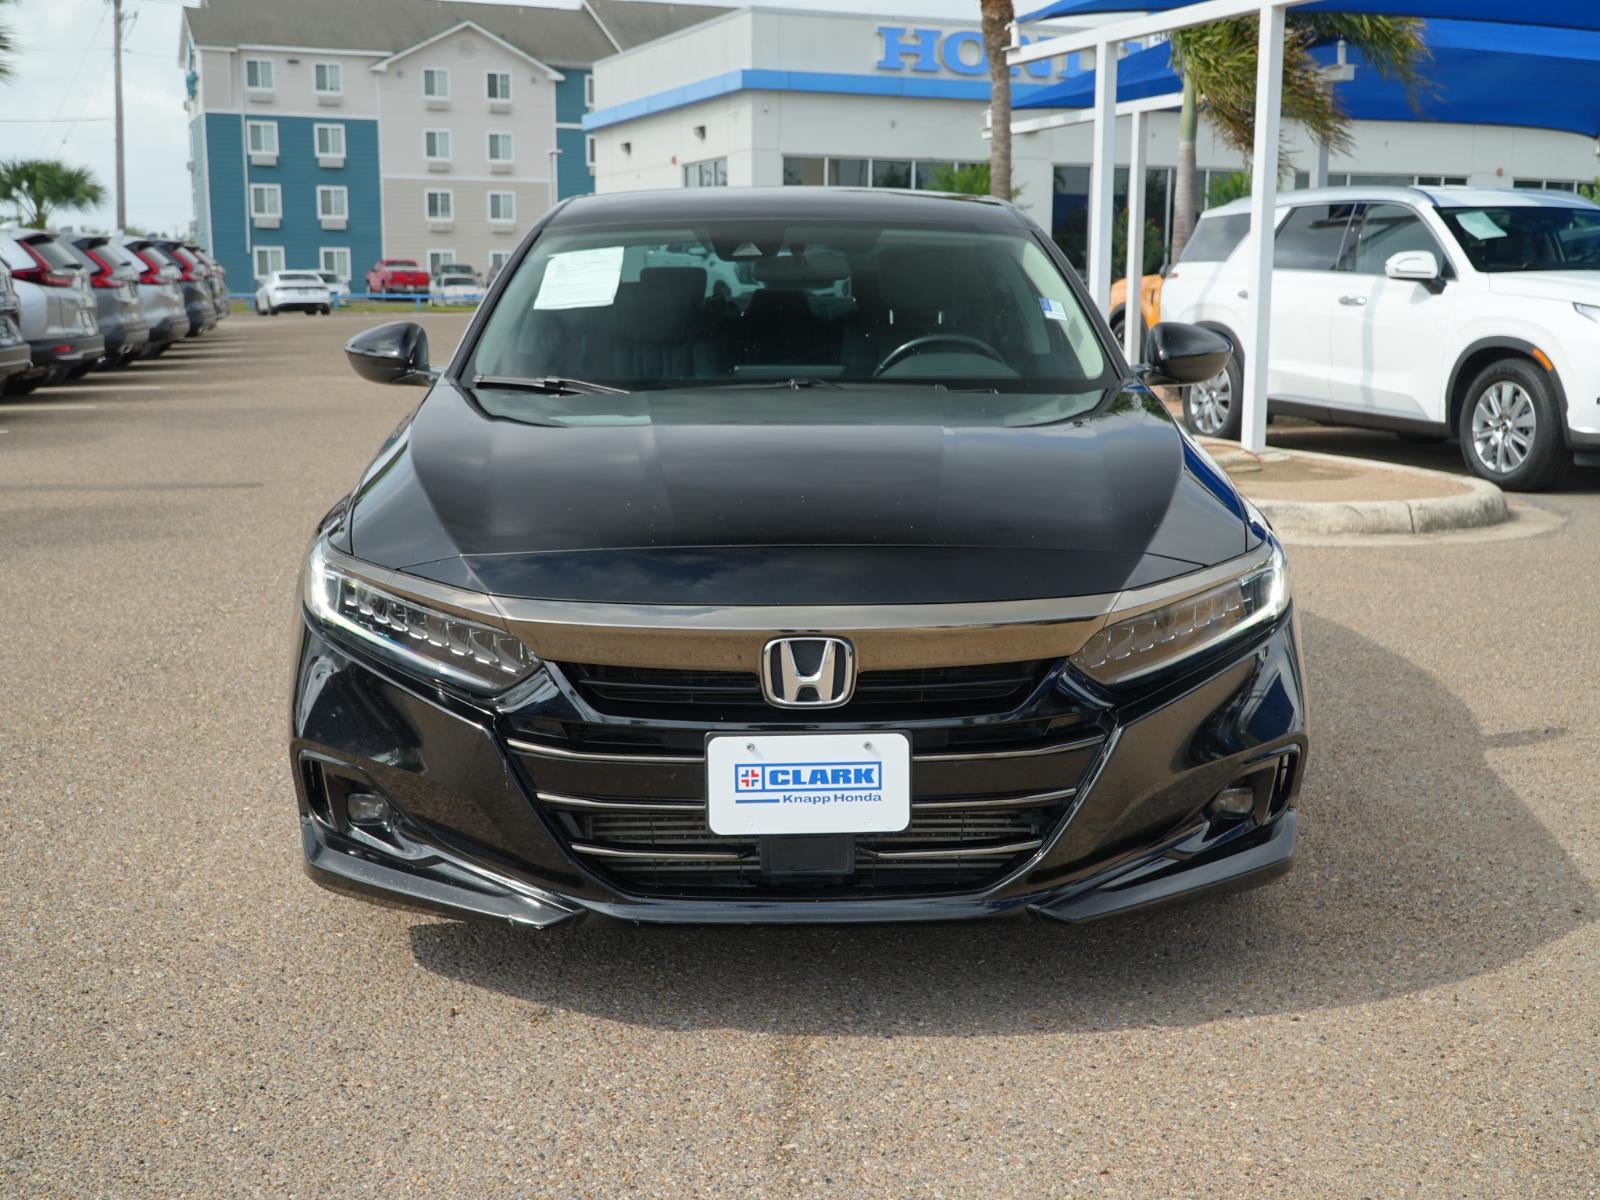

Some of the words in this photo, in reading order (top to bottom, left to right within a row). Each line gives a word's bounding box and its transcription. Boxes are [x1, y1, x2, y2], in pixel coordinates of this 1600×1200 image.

[876, 26, 1142, 79] HON
[769, 768, 875, 785] CLARK
[783, 794, 831, 805] Knapp
[834, 793, 882, 802] Honda
